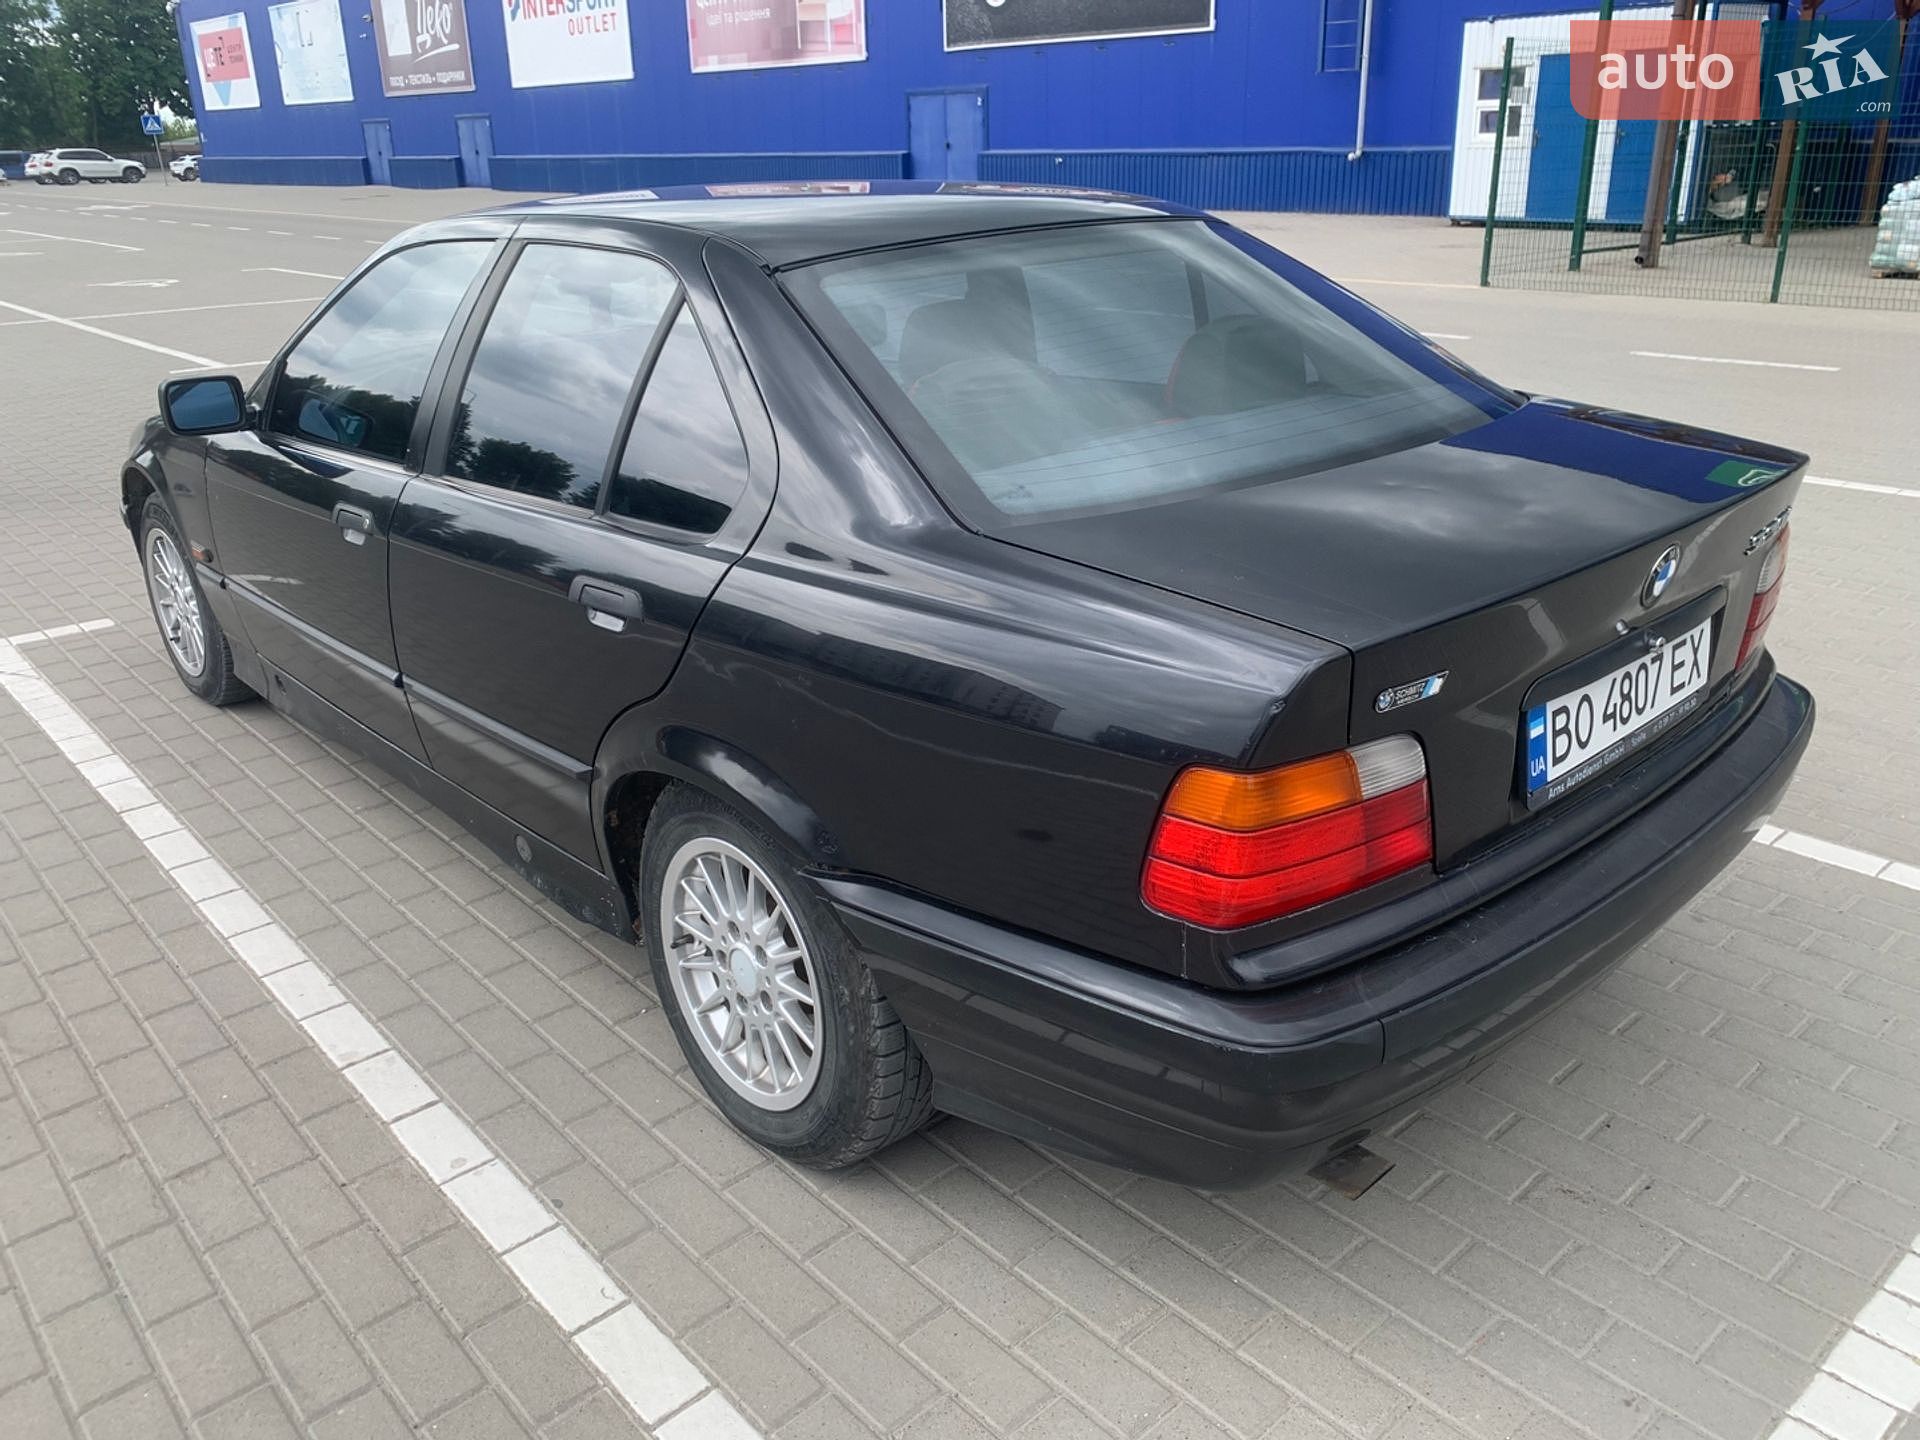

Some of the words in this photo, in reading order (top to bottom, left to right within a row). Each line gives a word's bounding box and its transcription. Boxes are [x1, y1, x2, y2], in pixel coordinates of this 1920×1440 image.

[568, 12, 616, 36] OUTLET
[1551, 692, 1595, 769] BO
[1602, 652, 1665, 732] 4807
[1669, 628, 1704, 697] EX
[1530, 755, 1546, 777] UA
